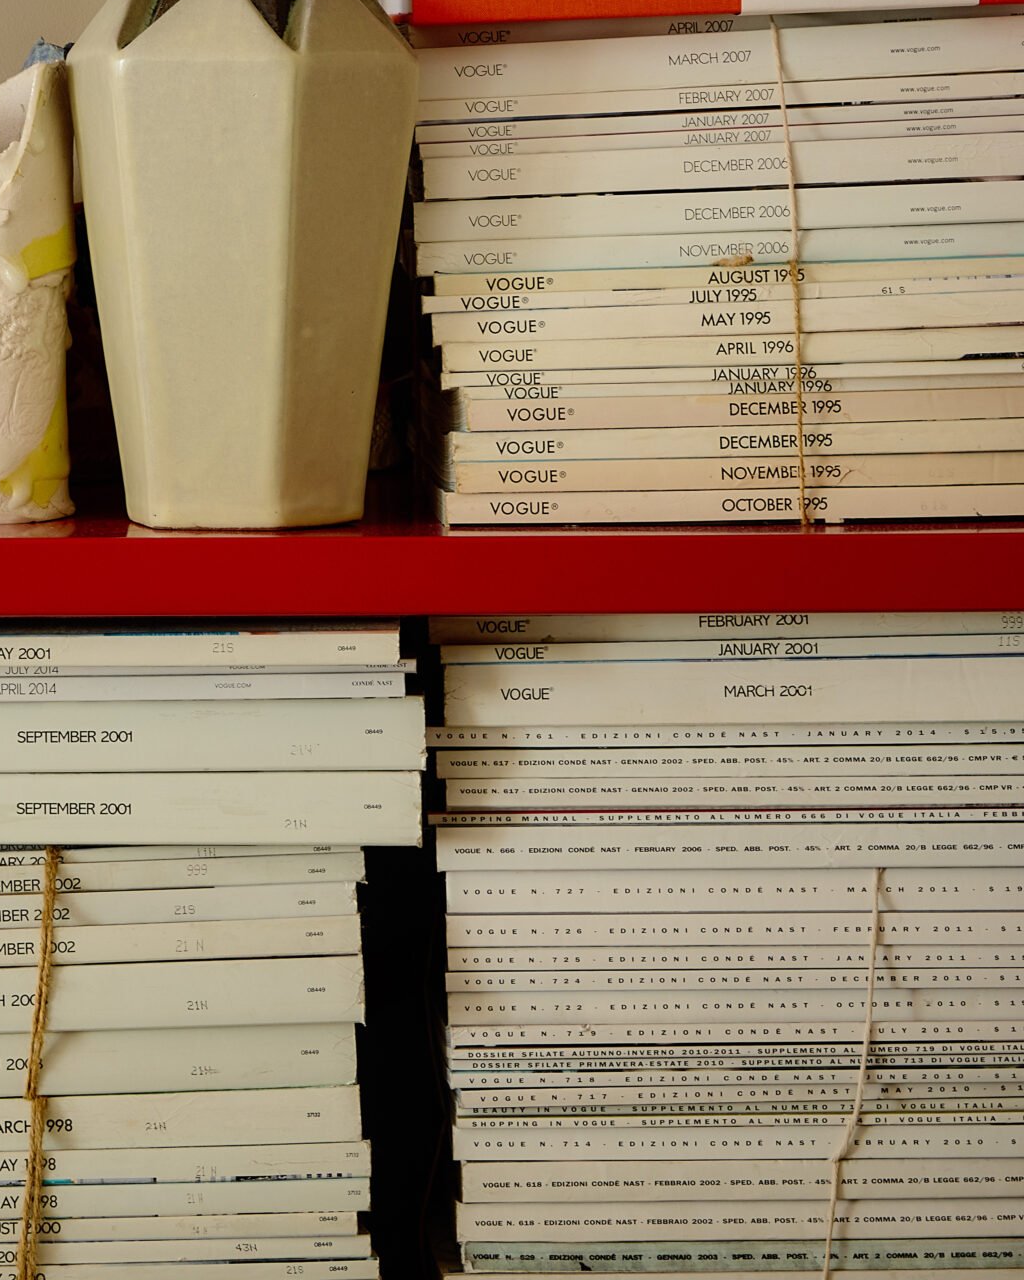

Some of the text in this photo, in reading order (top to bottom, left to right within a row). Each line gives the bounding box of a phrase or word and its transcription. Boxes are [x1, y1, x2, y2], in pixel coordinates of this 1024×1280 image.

[668, 52, 719, 66] MARCH
[721, 49, 752, 64] 2007
[890, 46, 941, 54] www.vogue.com
[678, 90, 742, 105] FEBRUARY
[744, 88, 775, 102] 2007
[900, 85, 950, 94] www.vogue.com
[684, 206, 756, 221] DECEMBER
[758, 205, 791, 219] 2006
[910, 205, 962, 213] www.vogue.com
[688, 289, 722, 304] JULY
[725, 288, 757, 303] 1995
[701, 312, 736, 327] MAY
[739, 311, 771, 326] 1995
[715, 341, 757, 356] APRIL
[762, 340, 794, 354] 1996
[719, 434, 799, 450] DECEMBER
[799, 432, 833, 448] 1995
[18, 647, 51, 660] 2001
[717, 642, 781, 657] JANUARY
[784, 642, 819, 655] 2001
[28, 682, 57, 695] 2014
[724, 684, 775, 698] MARCH
[779, 684, 813, 697] 2001
[17, 730, 97, 744] SEPTEMBER
[100, 730, 133, 743] 2001
[480, 759, 491, 769] N.
[691, 756, 718, 766] SPED.
[719, 756, 741, 766] ABB.
[16, 802, 96, 815] SEPTEMBER
[99, 802, 132, 816] 2001
[530, 886, 547, 896] N.
[613, 887, 695, 895] EDIZIONI
[708, 886, 763, 894] CONDÉ
